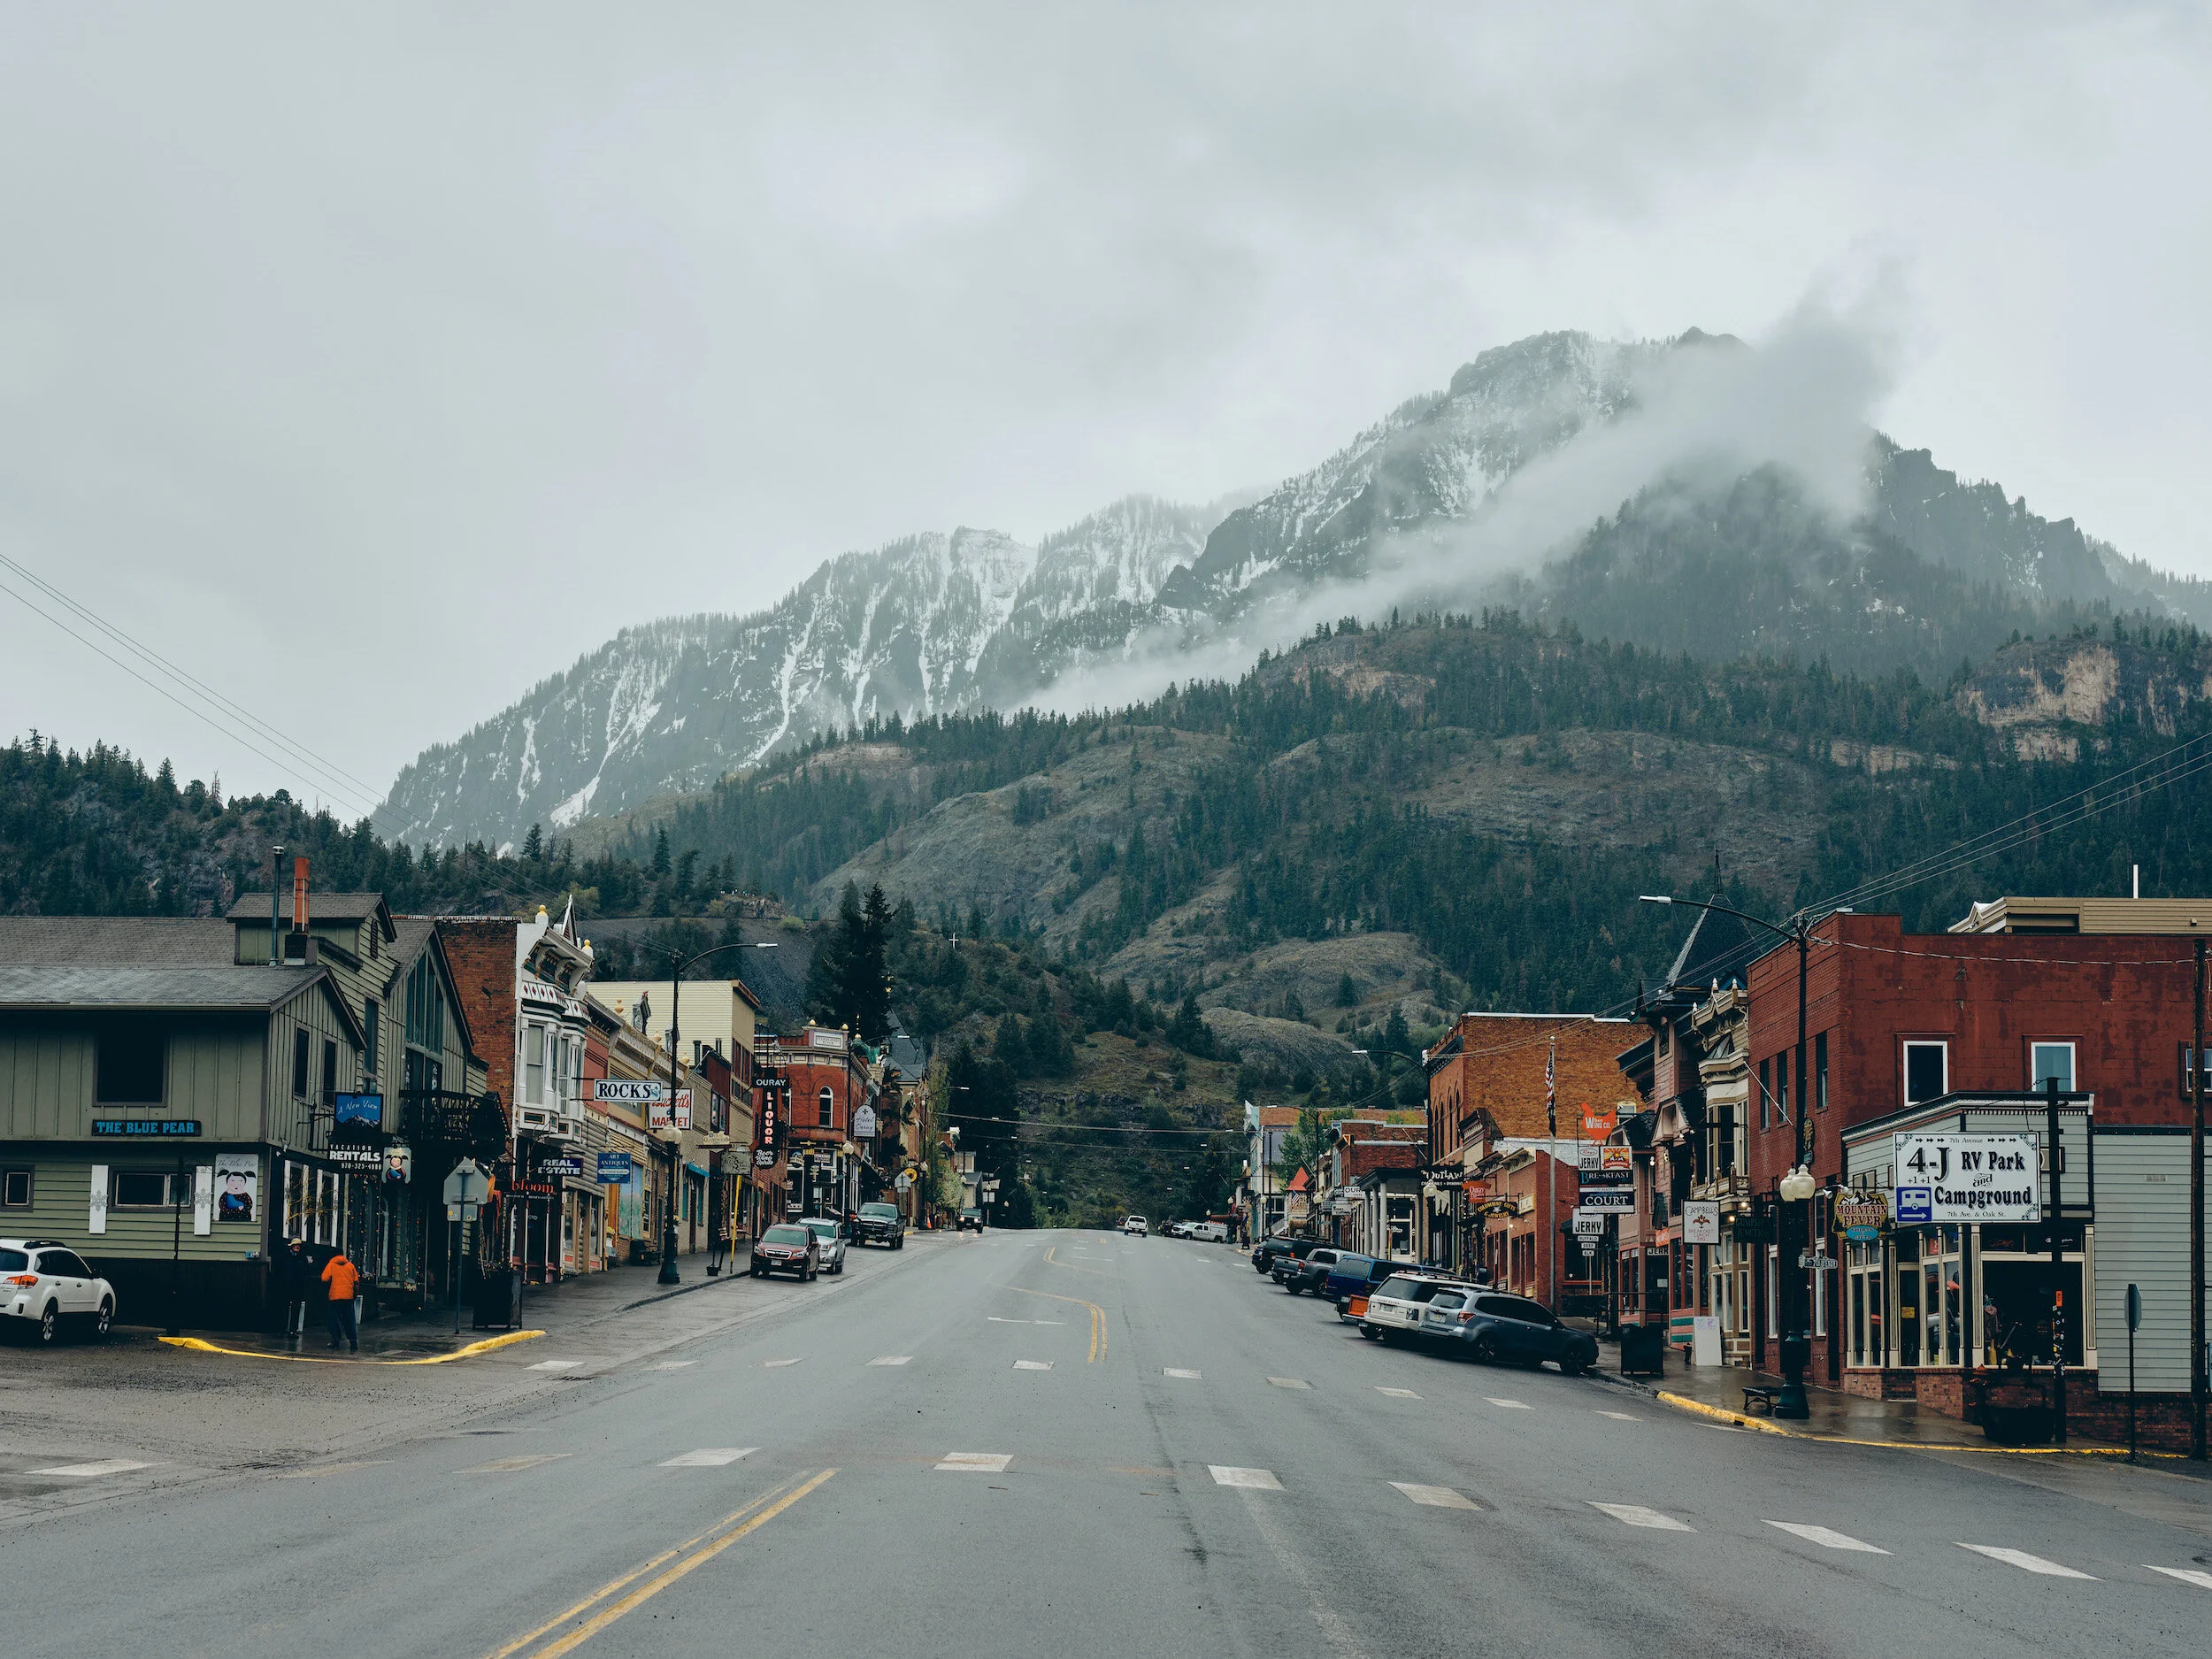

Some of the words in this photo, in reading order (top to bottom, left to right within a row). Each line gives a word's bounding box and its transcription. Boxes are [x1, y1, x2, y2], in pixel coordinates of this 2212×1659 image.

[599, 1082, 651, 1099] ROCKS
[338, 1105, 343, 1114] A
[346, 1101, 360, 1110] New
[363, 1100, 378, 1110] View
[652, 1116, 689, 1127] MAET
[764, 1091, 774, 1144] LIQUOR
[96, 1122, 121, 1133] THE
[126, 1122, 158, 1133] BLUE
[163, 1122, 194, 1133] PEAR
[329, 1150, 380, 1162] RENTALS
[1580, 1157, 1599, 1168] JERKY
[1907, 1147, 1951, 1181] 4-J
[1962, 1151, 1982, 1171] RV
[1988, 1151, 2025, 1171] Park
[511, 1178, 555, 1194] bloom
[1972, 1174, 1993, 1187] and
[1586, 1196, 1628, 1205] COURT
[1934, 1186, 2032, 1209] Campground
[1837, 1204, 1887, 1215] MOUNTAIN
[1575, 1221, 1601, 1233] JERKY
[1842, 1215, 1883, 1228] FEVER
